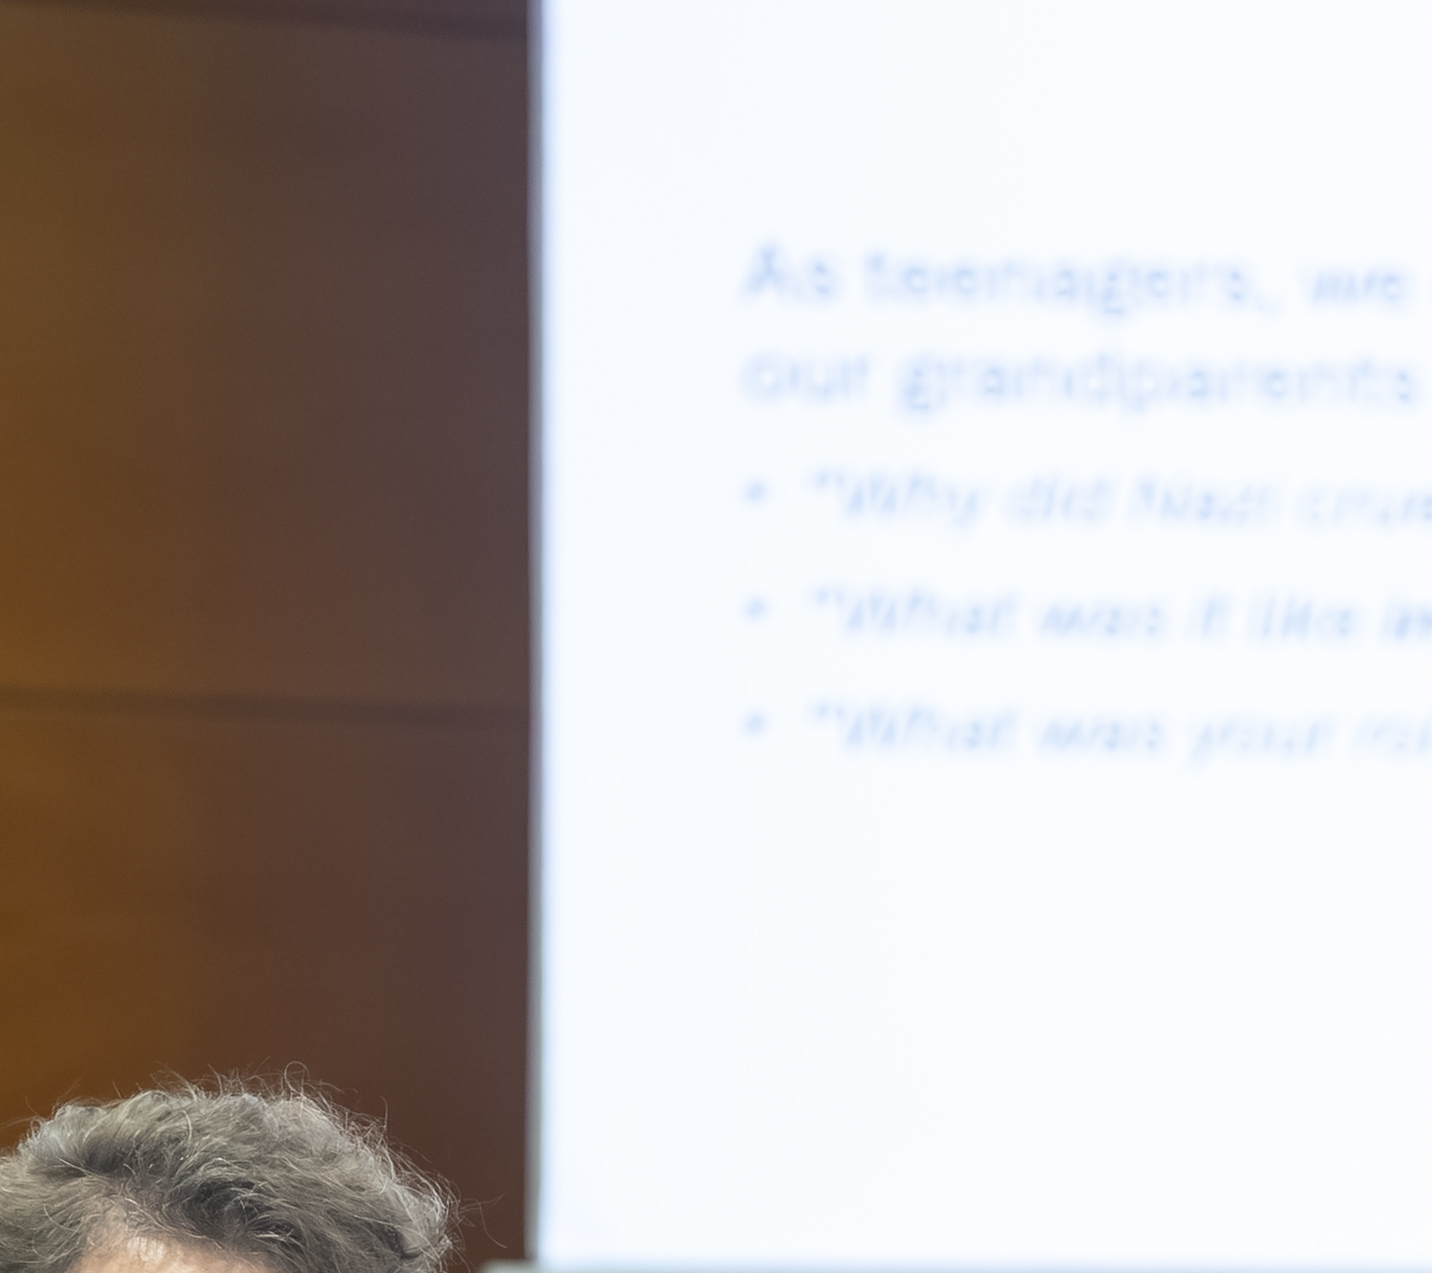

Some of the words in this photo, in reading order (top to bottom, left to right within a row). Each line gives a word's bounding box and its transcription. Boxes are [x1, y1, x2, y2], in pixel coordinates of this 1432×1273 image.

[742, 240, 840, 304] As
[864, 249, 1274, 324] teenagers,
[1306, 267, 1412, 309] we
[742, 352, 872, 404] our
[896, 351, 1419, 421] grandparents
[1009, 476, 1115, 525] did
[1038, 601, 1167, 641] was
[1251, 596, 1360, 641] like
[1038, 716, 1167, 756] was
[1189, 717, 1333, 763] your
